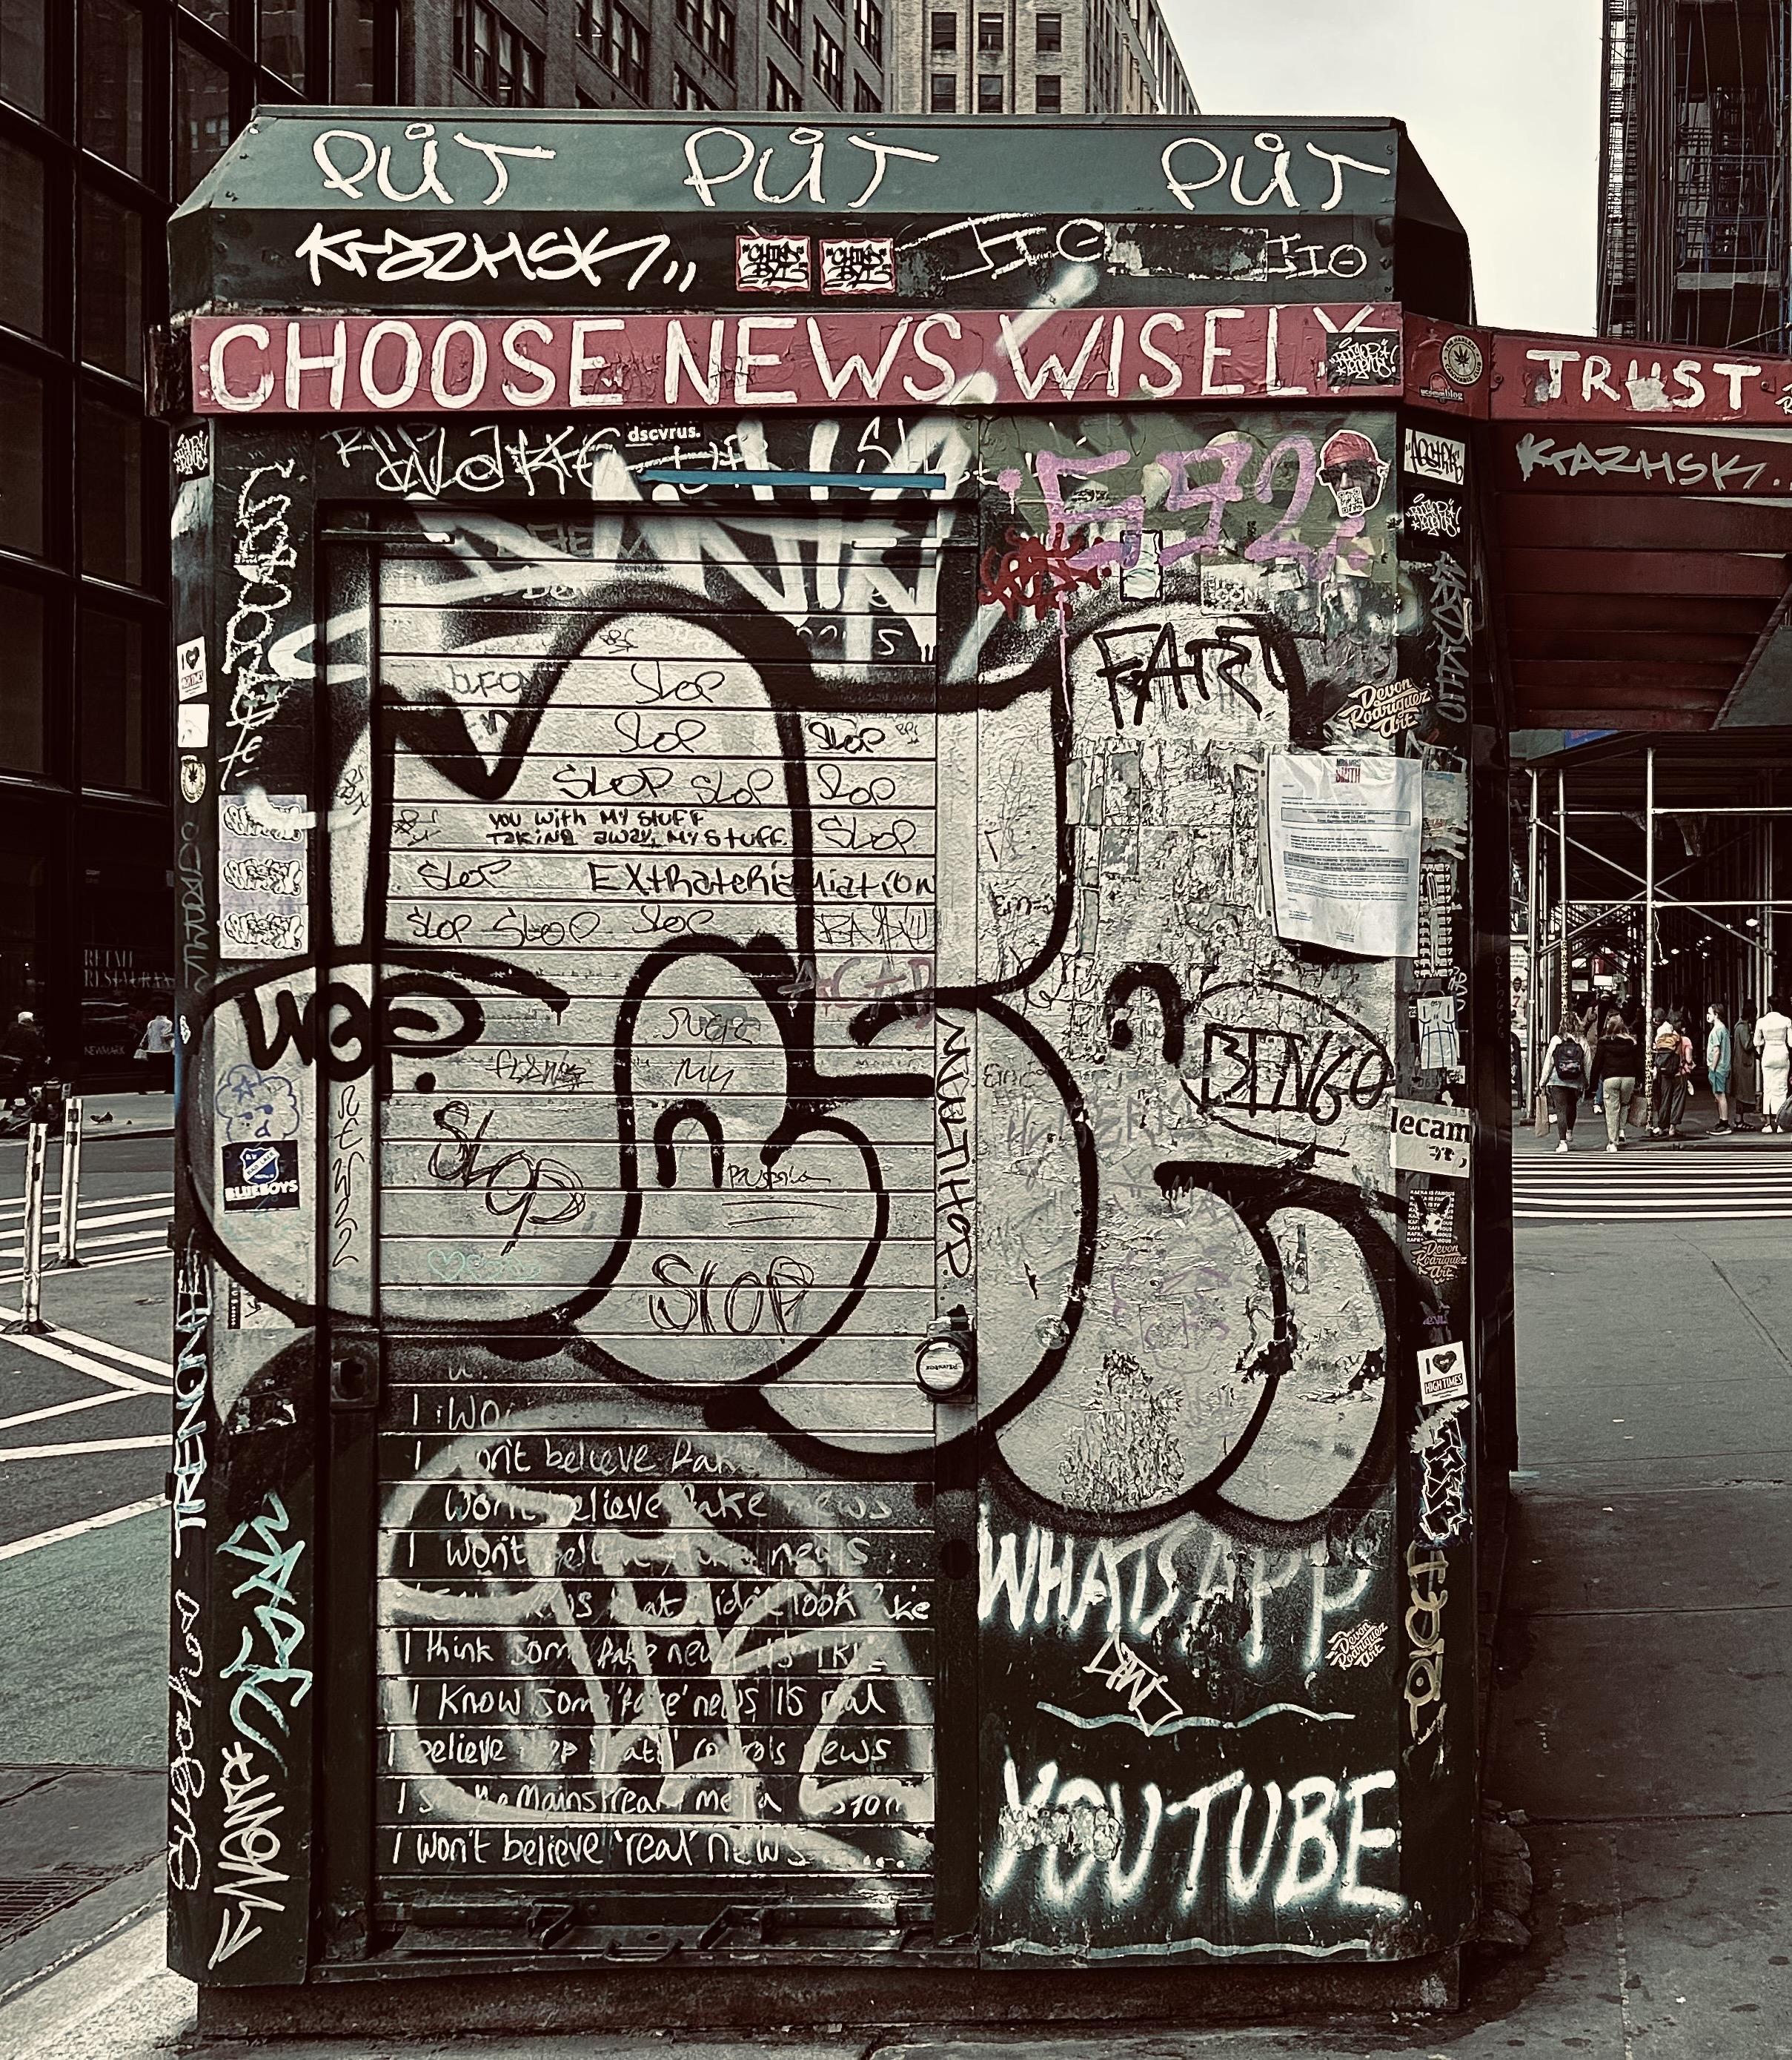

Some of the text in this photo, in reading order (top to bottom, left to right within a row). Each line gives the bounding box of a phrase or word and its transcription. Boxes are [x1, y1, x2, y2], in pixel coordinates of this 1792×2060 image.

[208, 317, 625, 412] CHOOSE
[666, 313, 962, 407] NEWS
[627, 424, 701, 443] dscvrus.
[1348, 678, 1413, 706] Devon
[1338, 689, 1433, 731] Rodriguez
[1370, 712, 1418, 739] Art
[1421, 1239, 1459, 1256] Devon
[1424, 1265, 1459, 1279] Art
[1424, 1374, 1463, 1394] HIGH TIMES
[545, 1437, 655, 1474] believe
[557, 1487, 663, 1522] elieve
[427, 1630, 494, 1663] think
[1330, 1622, 1372, 1655] Devon
[1330, 1622, 1389, 1671] Rodriguez
[1353, 1644, 1387, 1668] Art
[821, 1740, 892, 1766] ews
[502, 1829, 604, 1868] believe
[984, 1758, 1405, 1912] YOUTUBE
